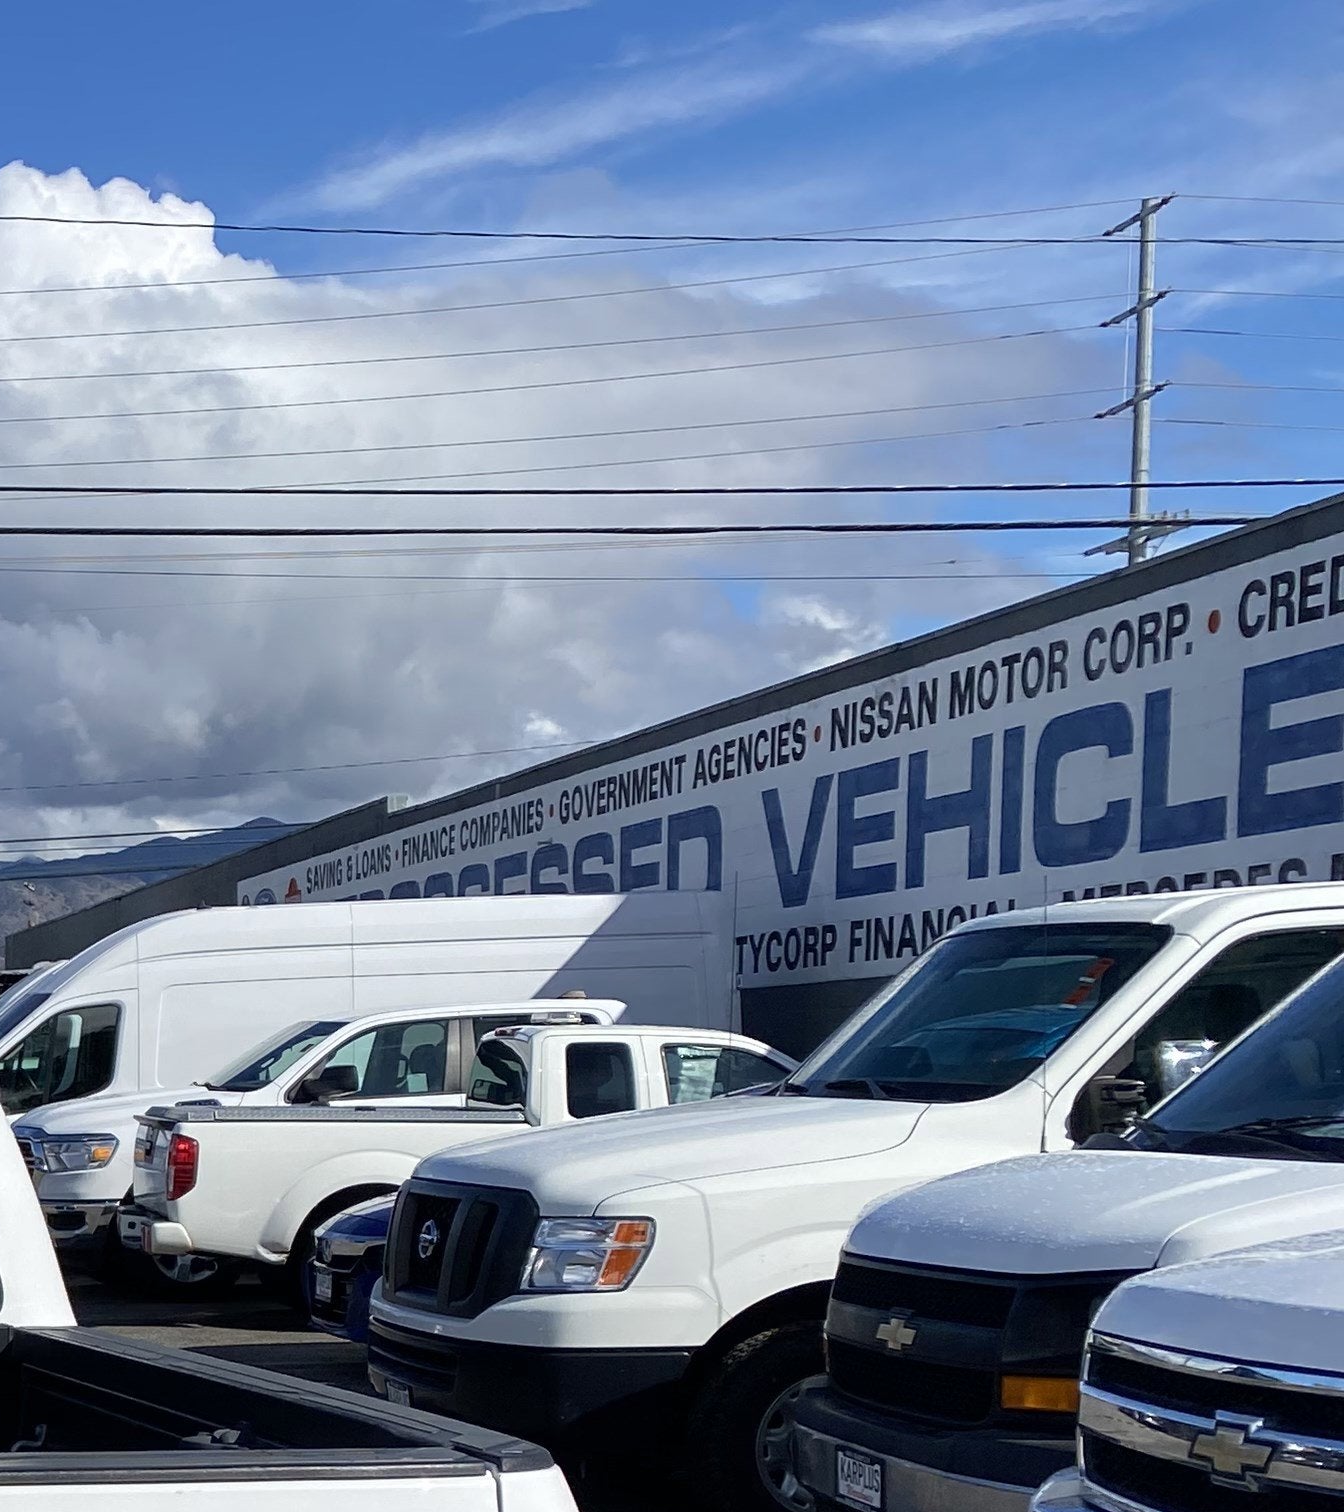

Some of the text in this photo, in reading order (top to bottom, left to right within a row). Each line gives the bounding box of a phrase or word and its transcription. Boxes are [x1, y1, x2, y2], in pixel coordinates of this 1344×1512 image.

[306, 859, 342, 894] SAVING
[346, 856, 352, 882] &
[356, 844, 391, 880] LOANS
[402, 825, 455, 867] FINANCE
[460, 798, 543, 851] COMPANIES
[559, 754, 687, 824] GOVERNMENT
[693, 718, 807, 790] AGENCIES
[829, 678, 938, 752] NISSAN
[948, 639, 1069, 720] MOTOR
[1084, 602, 1193, 682] CORP.
[761, 644, 1344, 908] VEHICLE
[848, 899, 1015, 963] FINAN
[840, 1456, 880, 1493] KARPLUS
